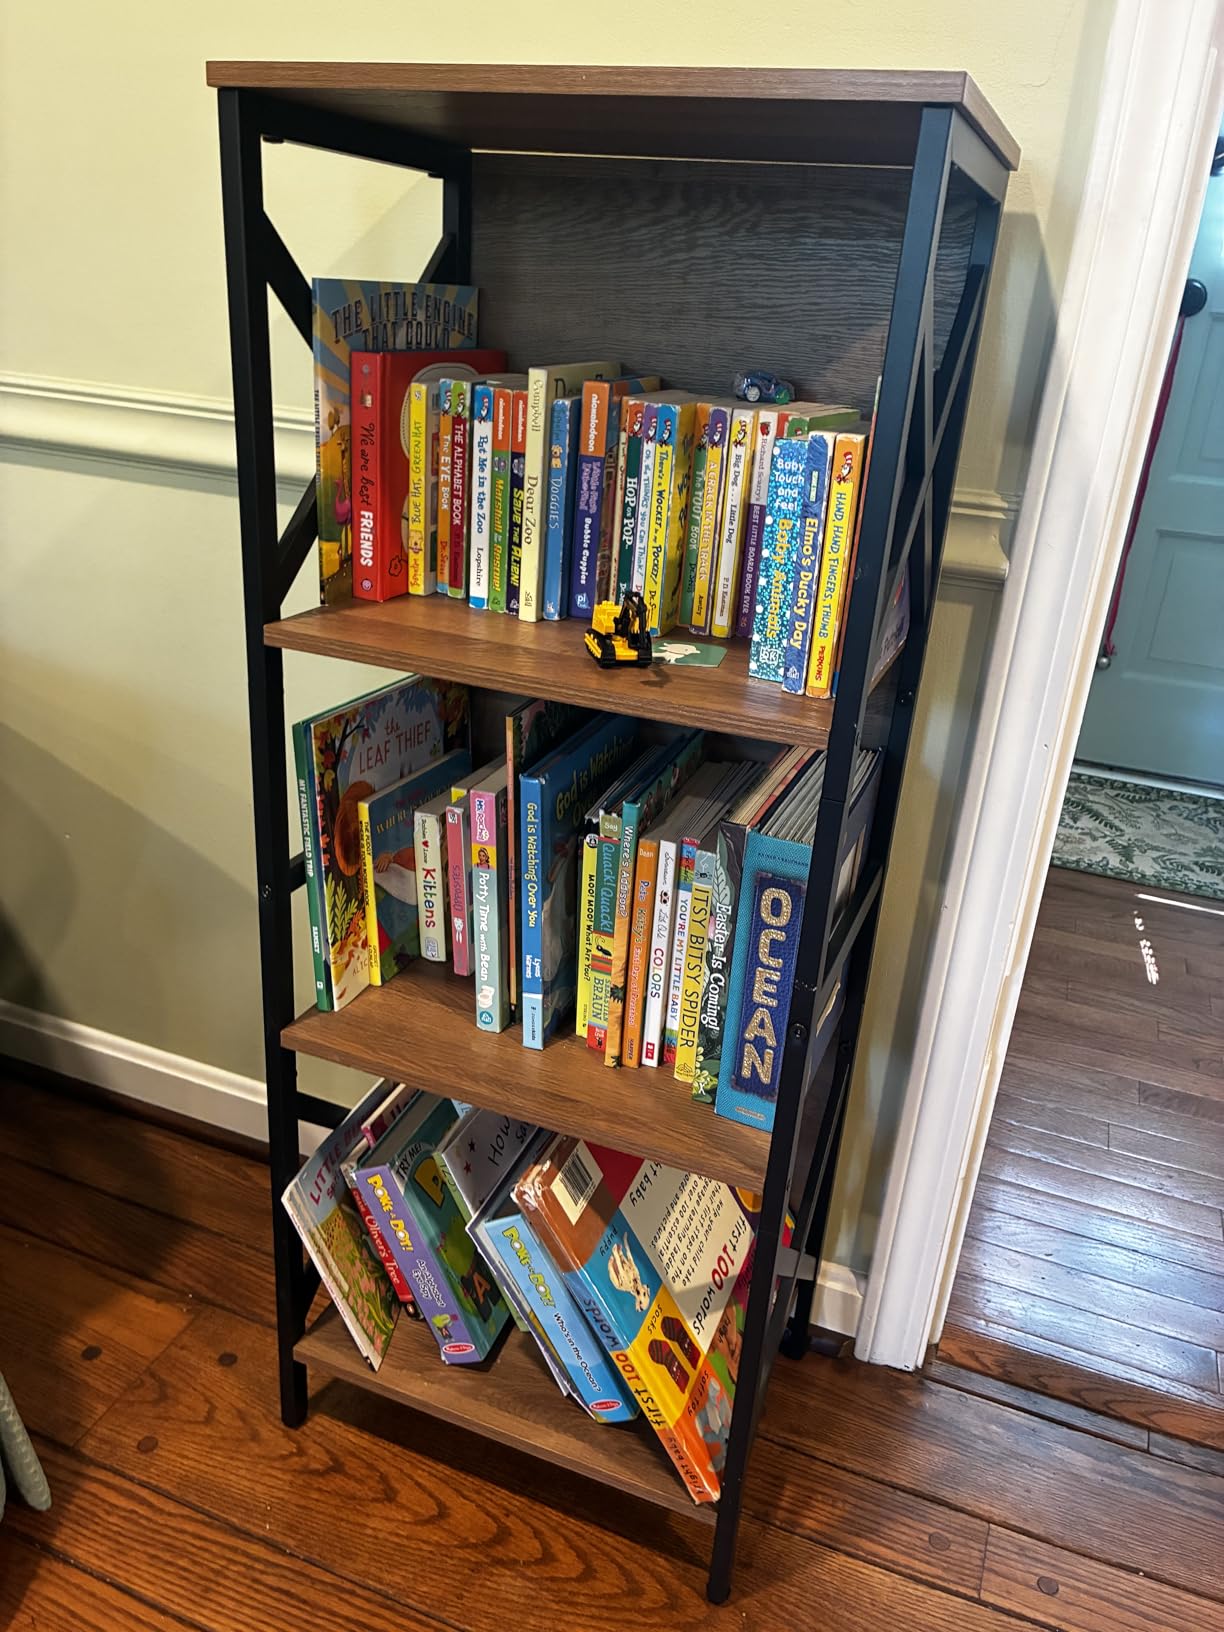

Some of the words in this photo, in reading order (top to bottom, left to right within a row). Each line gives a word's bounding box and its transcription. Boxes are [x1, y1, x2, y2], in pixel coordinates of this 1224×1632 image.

[332, 299, 364, 342] THE
[370, 289, 418, 323] LITTLE
[425, 294, 475, 338] ENGINE
[362, 320, 398, 350] THAT
[405, 320, 450, 350] COULD
[360, 422, 376, 446] We
[412, 420, 423, 439] HAT
[454, 423, 464, 444] THE
[588, 393, 600, 452] nickelodeon
[411, 440, 422, 474] GREEN
[478, 435, 489, 455] Put
[757, 438, 769, 470] Richard
[360, 448, 369, 472] are
[441, 456, 451, 482] EYE
[452, 446, 463, 498] ALPHABET
[478, 456, 488, 473] Me
[733, 453, 742, 469] Big
[777, 458, 804, 472] Baby
[359, 475, 376, 506] best
[478, 475, 488, 488] in
[625, 476, 639, 507] HOP
[705, 470, 717, 508] CRACK
[731, 470, 741, 487] Dog
[774, 471, 805, 484] Touch
[777, 486, 799, 498] and
[476, 491, 487, 510] the
[525, 476, 539, 514] Dear
[548, 476, 564, 530] DOGGIES
[640, 476, 651, 509] THINKS
[832, 491, 847, 522] HAND,
[410, 501, 422, 524] BLUE
[452, 499, 462, 526] BOOK
[640, 511, 648, 528] you
[653, 488, 667, 529] WOCKET
[703, 510, 713, 522] IN
[727, 503, 738, 527] Little
[751, 505, 761, 524] BEST
[476, 513, 486, 534] Zoo
[524, 517, 536, 545] Zoo
[582, 517, 593, 549] Bubble
[622, 517, 636, 546] POP
[639, 528, 647, 544] Can
[701, 524, 712, 544] THE
[725, 528, 735, 544] Dog
[749, 524, 760, 546] LITTLE
[360, 510, 374, 567] FRIENDS
[772, 519, 793, 564] Baby
[801, 518, 819, 567] Elmo's
[828, 525, 844, 555] HAND,
[636, 544, 647, 577] Think!
[648, 544, 663, 586] POCKET!
[698, 545, 710, 581] TRACK
[746, 546, 757, 573] BOARD
[744, 573, 754, 595] BOOK
[822, 557, 839, 602] FINGERS,
[741, 595, 752, 614] EVER
[767, 569, 787, 639] Animals
[793, 571, 812, 618] Ducky
[789, 621, 807, 650] Day
[818, 603, 832, 639] THUMB
[815, 645, 826, 681] PERKINS
[384, 717, 401, 737] the
[359, 739, 391, 775] LEAF
[398, 720, 432, 757] THIEF
[298, 778, 306, 793] MY
[299, 793, 311, 836] FANTASTIC
[527, 802, 538, 824] God
[527, 824, 536, 834] is
[303, 836, 313, 859] FIELD
[524, 835, 539, 882] Watching
[621, 825, 634, 868] Where's
[305, 859, 314, 878] TRIP
[603, 843, 616, 887] Quack!
[421, 867, 437, 929] Kittens
[476, 871, 490, 903] Potty
[526, 882, 538, 910] Over
[586, 874, 595, 898] MOO!
[618, 870, 630, 919] Addison?
[640, 880, 651, 902] Pete
[479, 903, 490, 932] Time
[527, 910, 539, 928] You
[585, 901, 594, 925] MOO!
[599, 888, 614, 933] Quack!
[676, 898, 688, 938] YOU'RE
[691, 887, 710, 929] ITSY
[585, 925, 593, 946] What
[714, 903, 732, 948] Easter
[479, 933, 487, 952] with
[584, 948, 593, 962] Are
[675, 939, 685, 955] MY
[479, 953, 490, 982] Bean
[583, 963, 592, 982] You?
[650, 947, 665, 999] COLORS
[686, 933, 705, 986] BITSY
[711, 954, 727, 970] Is
[671, 956, 683, 993] LITTLE
[741, 887, 792, 1085] OCEAN
[591, 976, 605, 1021] BRAUN
[669, 993, 681, 1022] BABY
[701, 972, 726, 1031] Coming!
[679, 988, 700, 1048] SPIDER
[487, 1115, 511, 1167] HOW
[309, 1142, 342, 1206] LITTLE
[396, 1157, 412, 1182] TRY
[408, 1142, 423, 1160] ME!
[630, 1173, 653, 1208] baby
[669, 1193, 681, 1214] and
[687, 1179, 699, 1202] over
[708, 1182, 722, 1204] their
[678, 1200, 690, 1219] 100
[698, 1204, 711, 1228] first
[713, 1199, 724, 1218] Help
[650, 1206, 672, 1250] pictures.
[677, 1206, 699, 1244] learning
[686, 1225, 701, 1253] steps
[703, 1217, 714, 1242] your
[728, 1215, 747, 1252] first
[364, 1214, 389, 1258] Oliver's
[385, 1259, 400, 1285] Tree
[600, 1225, 618, 1257] puppy
[657, 1217, 681, 1264] essential
[692, 1240, 705, 1267] child
[663, 1243, 682, 1277] ladder
[680, 1252, 688, 1267] on
[711, 1243, 735, 1291] 100
[671, 1266, 684, 1284] the
[682, 1264, 695, 1287] take
[583, 1298, 621, 1349] words
[647, 1303, 663, 1335] socks
[692, 1287, 716, 1336] words
[554, 1312, 571, 1342] Who's
[572, 1345, 583, 1362] the
[579, 1361, 603, 1393] Ocean?
[614, 1352, 641, 1381] 100
[698, 1370, 710, 1397] soft
[633, 1388, 667, 1428] first
[687, 1395, 701, 1418] toy
